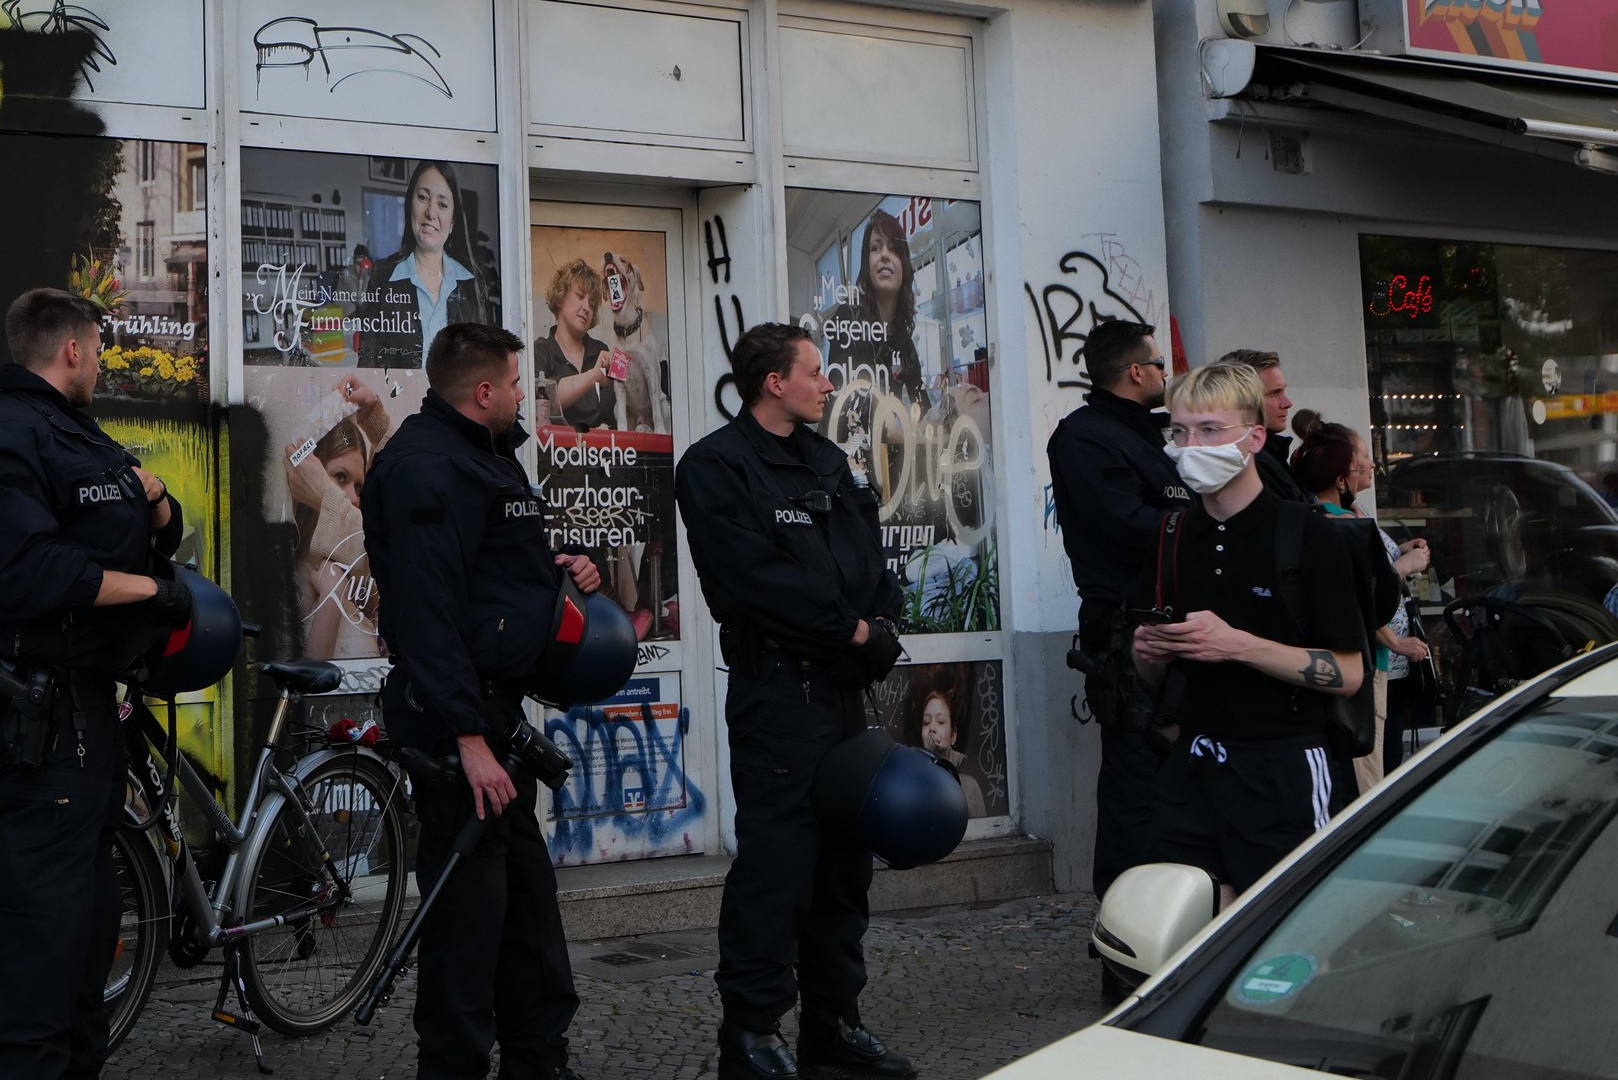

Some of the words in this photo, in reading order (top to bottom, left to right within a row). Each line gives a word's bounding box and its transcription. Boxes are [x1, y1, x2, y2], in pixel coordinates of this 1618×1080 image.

[319, 285, 358, 302] Name
[360, 287, 382, 304] auf
[385, 287, 411, 304] dem
[1388, 274, 1433, 320] Café
[822, 317, 888, 349] eigener
[534, 433, 638, 467] Modische
[78, 484, 123, 503] POLIZEI
[505, 501, 541, 518] POLIZE
[775, 509, 812, 525] POLIZEI
[626, 686, 652, 696] antreibt.
[662, 706, 674, 716] frei.
